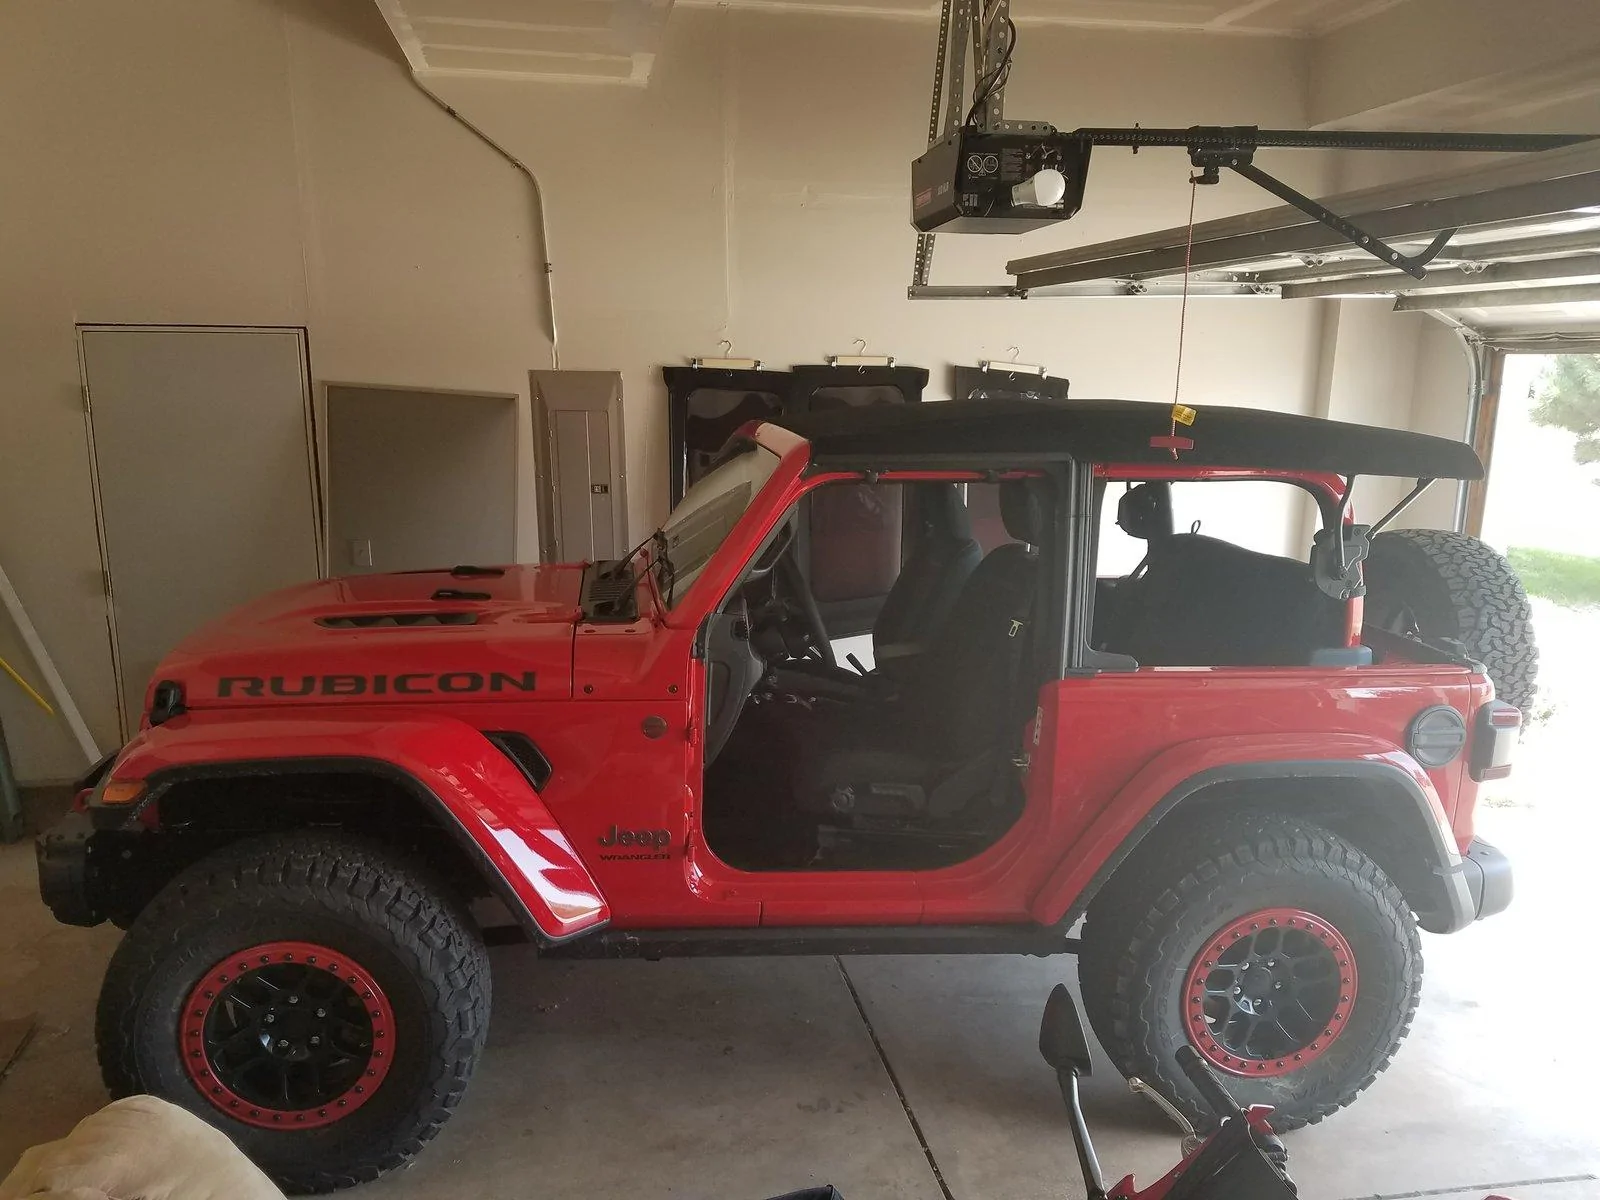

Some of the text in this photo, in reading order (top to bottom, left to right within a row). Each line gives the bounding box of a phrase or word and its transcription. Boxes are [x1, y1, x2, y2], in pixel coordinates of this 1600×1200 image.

[217, 671, 537, 697] RUBICON
[597, 824, 672, 851] Jeep
[599, 853, 671, 861] WRANGLER
